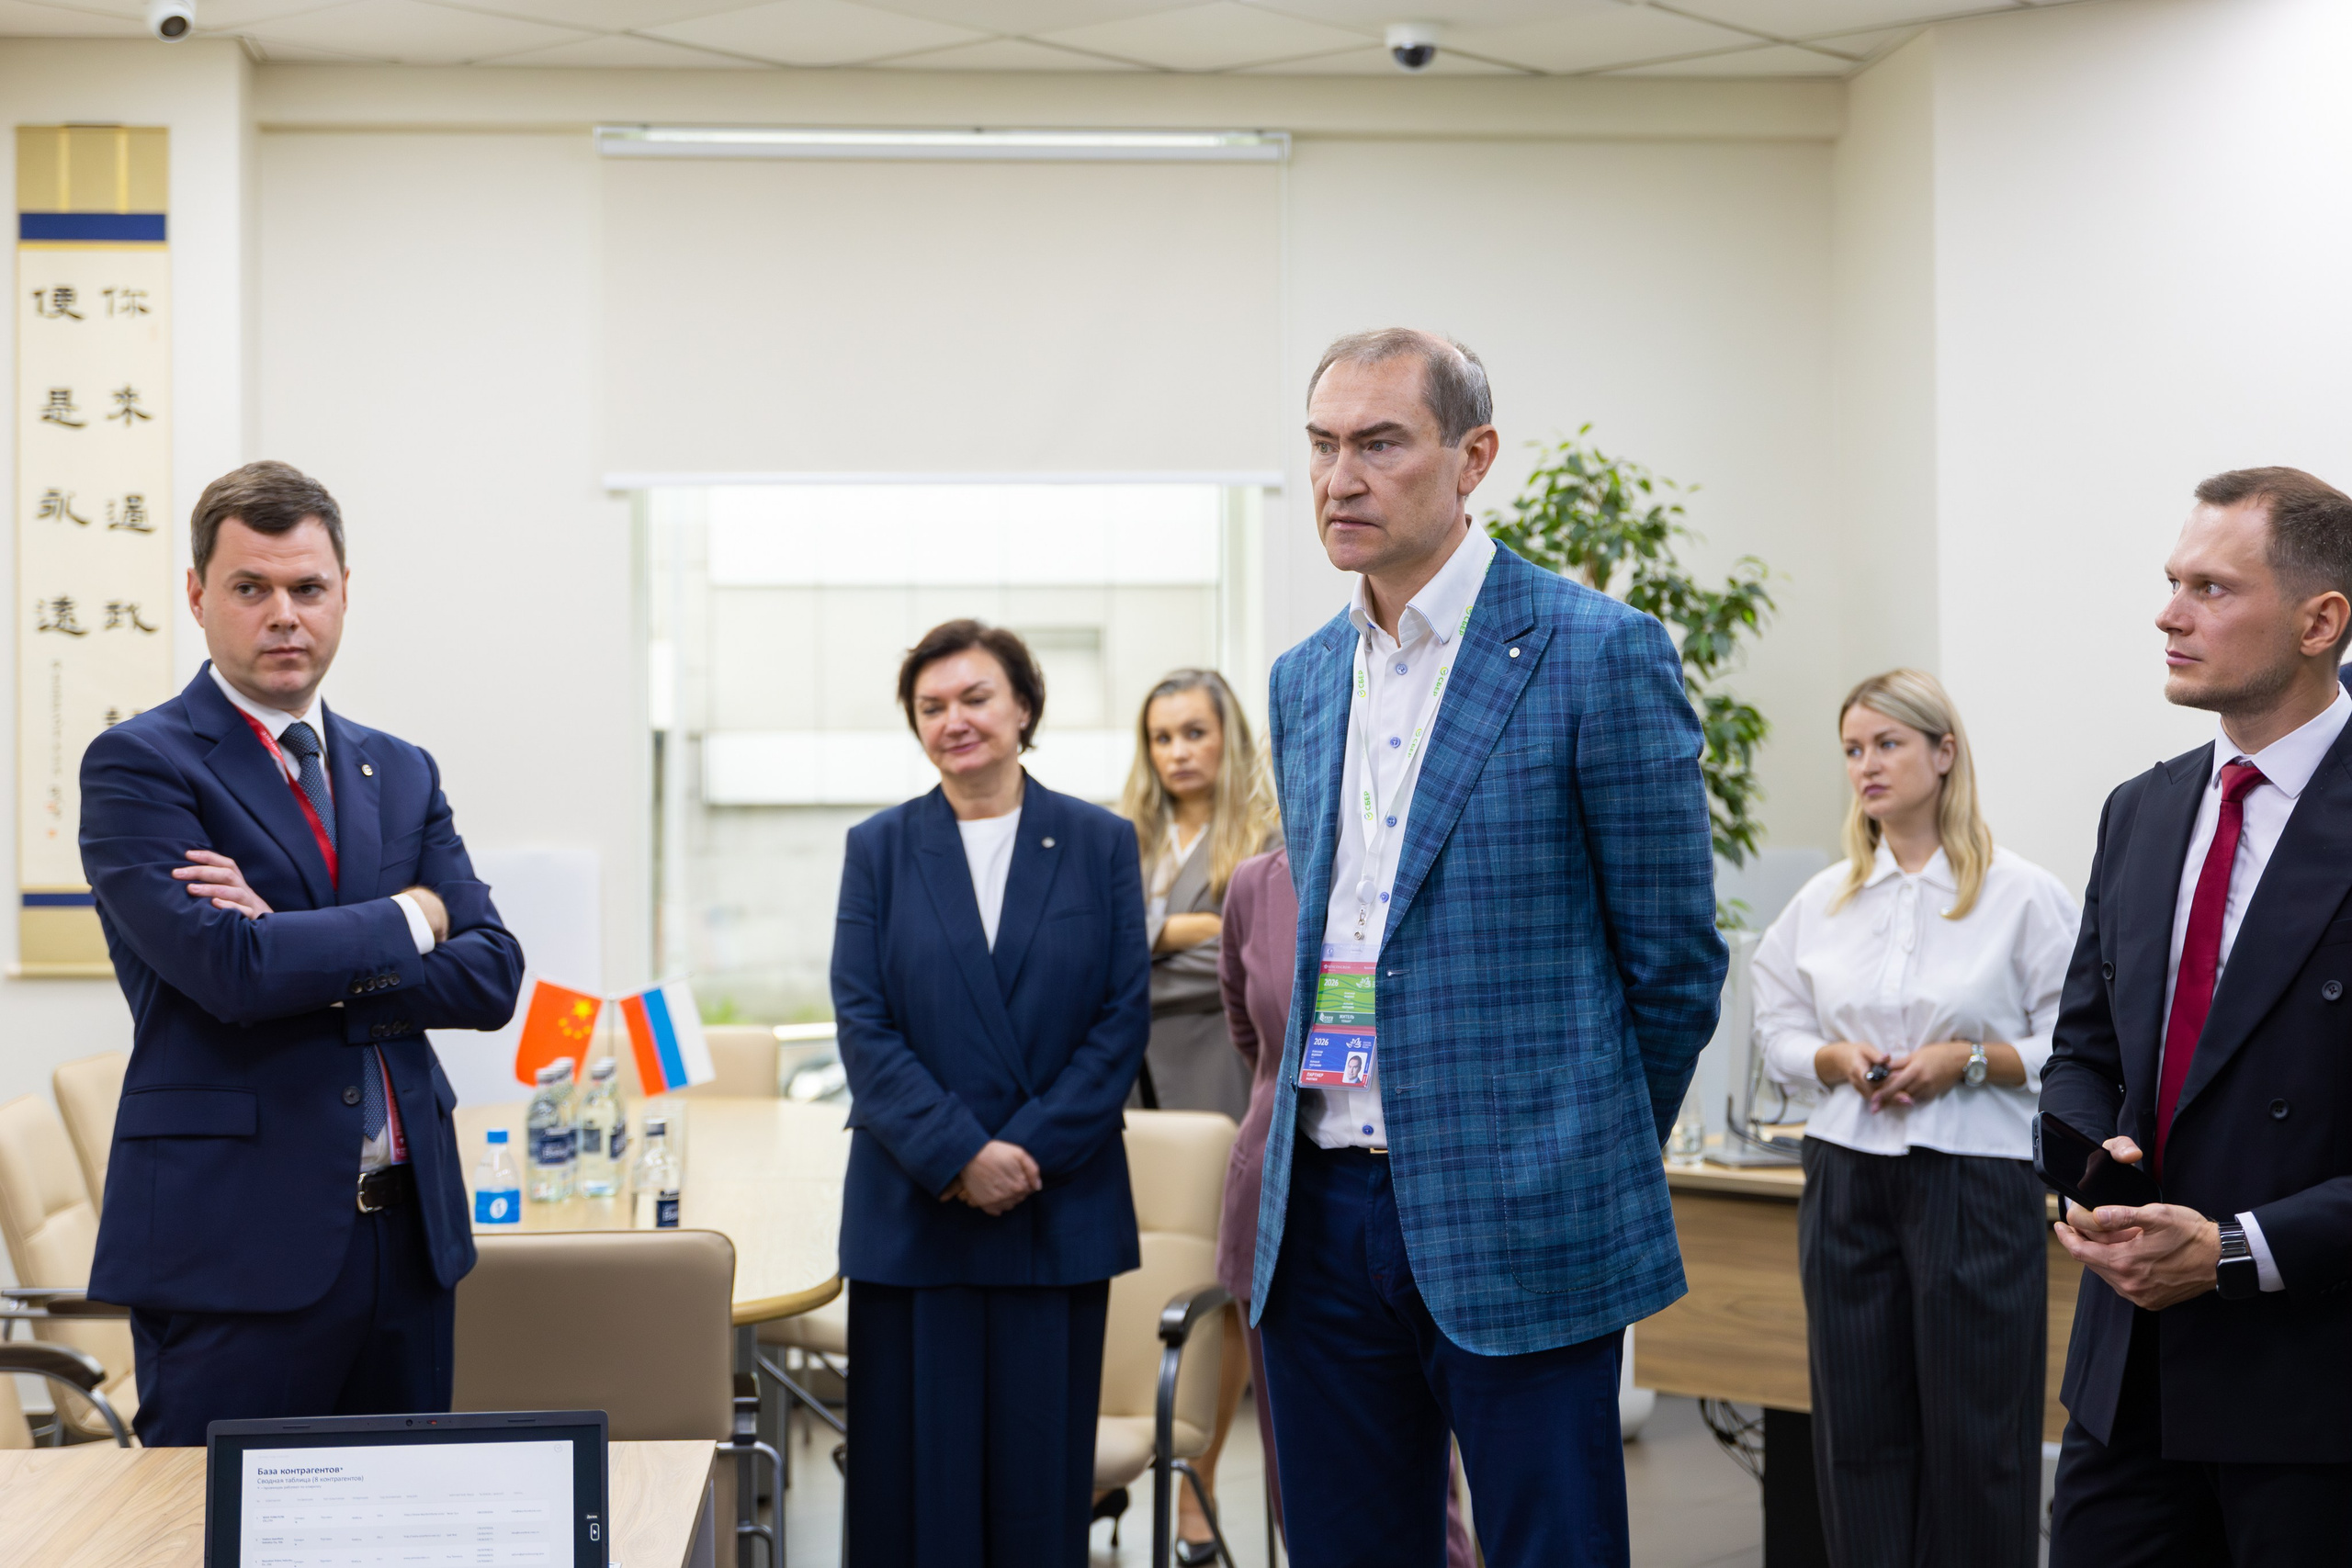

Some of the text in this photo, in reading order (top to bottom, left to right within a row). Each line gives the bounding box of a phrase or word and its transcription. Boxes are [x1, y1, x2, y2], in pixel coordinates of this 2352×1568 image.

[1459, 615, 1469, 637] СБЕР
[1432, 676, 1444, 697] СБЕР
[1363, 790, 1372, 811] СБЕР
[1324, 979, 1340, 987] 2026
[1314, 1038, 1329, 1046] 2026
[320, 1475, 365, 1483] контрагентов)
